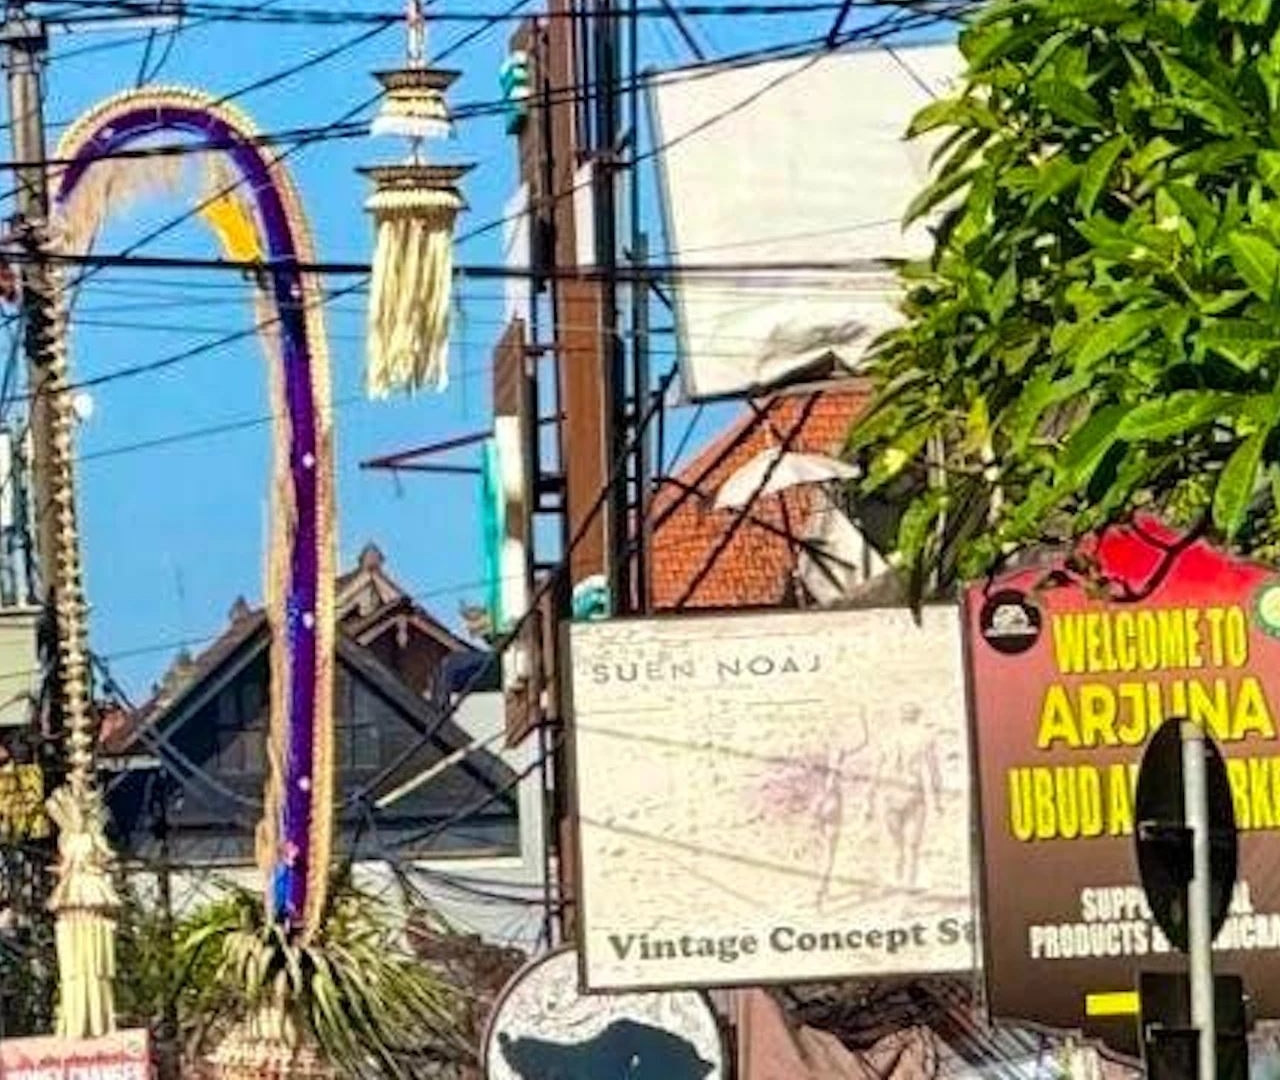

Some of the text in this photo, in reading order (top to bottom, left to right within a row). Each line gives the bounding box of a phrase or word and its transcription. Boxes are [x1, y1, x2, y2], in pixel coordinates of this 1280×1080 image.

[1053, 604, 1249, 674] WELCOME TO
[591, 654, 823, 685] SUEN NOAJ
[1009, 765, 1102, 841] UBUD
[607, 932, 759, 962] Vintage
[769, 923, 929, 954] Concept
[1029, 921, 1149, 958] PRODUCTS
